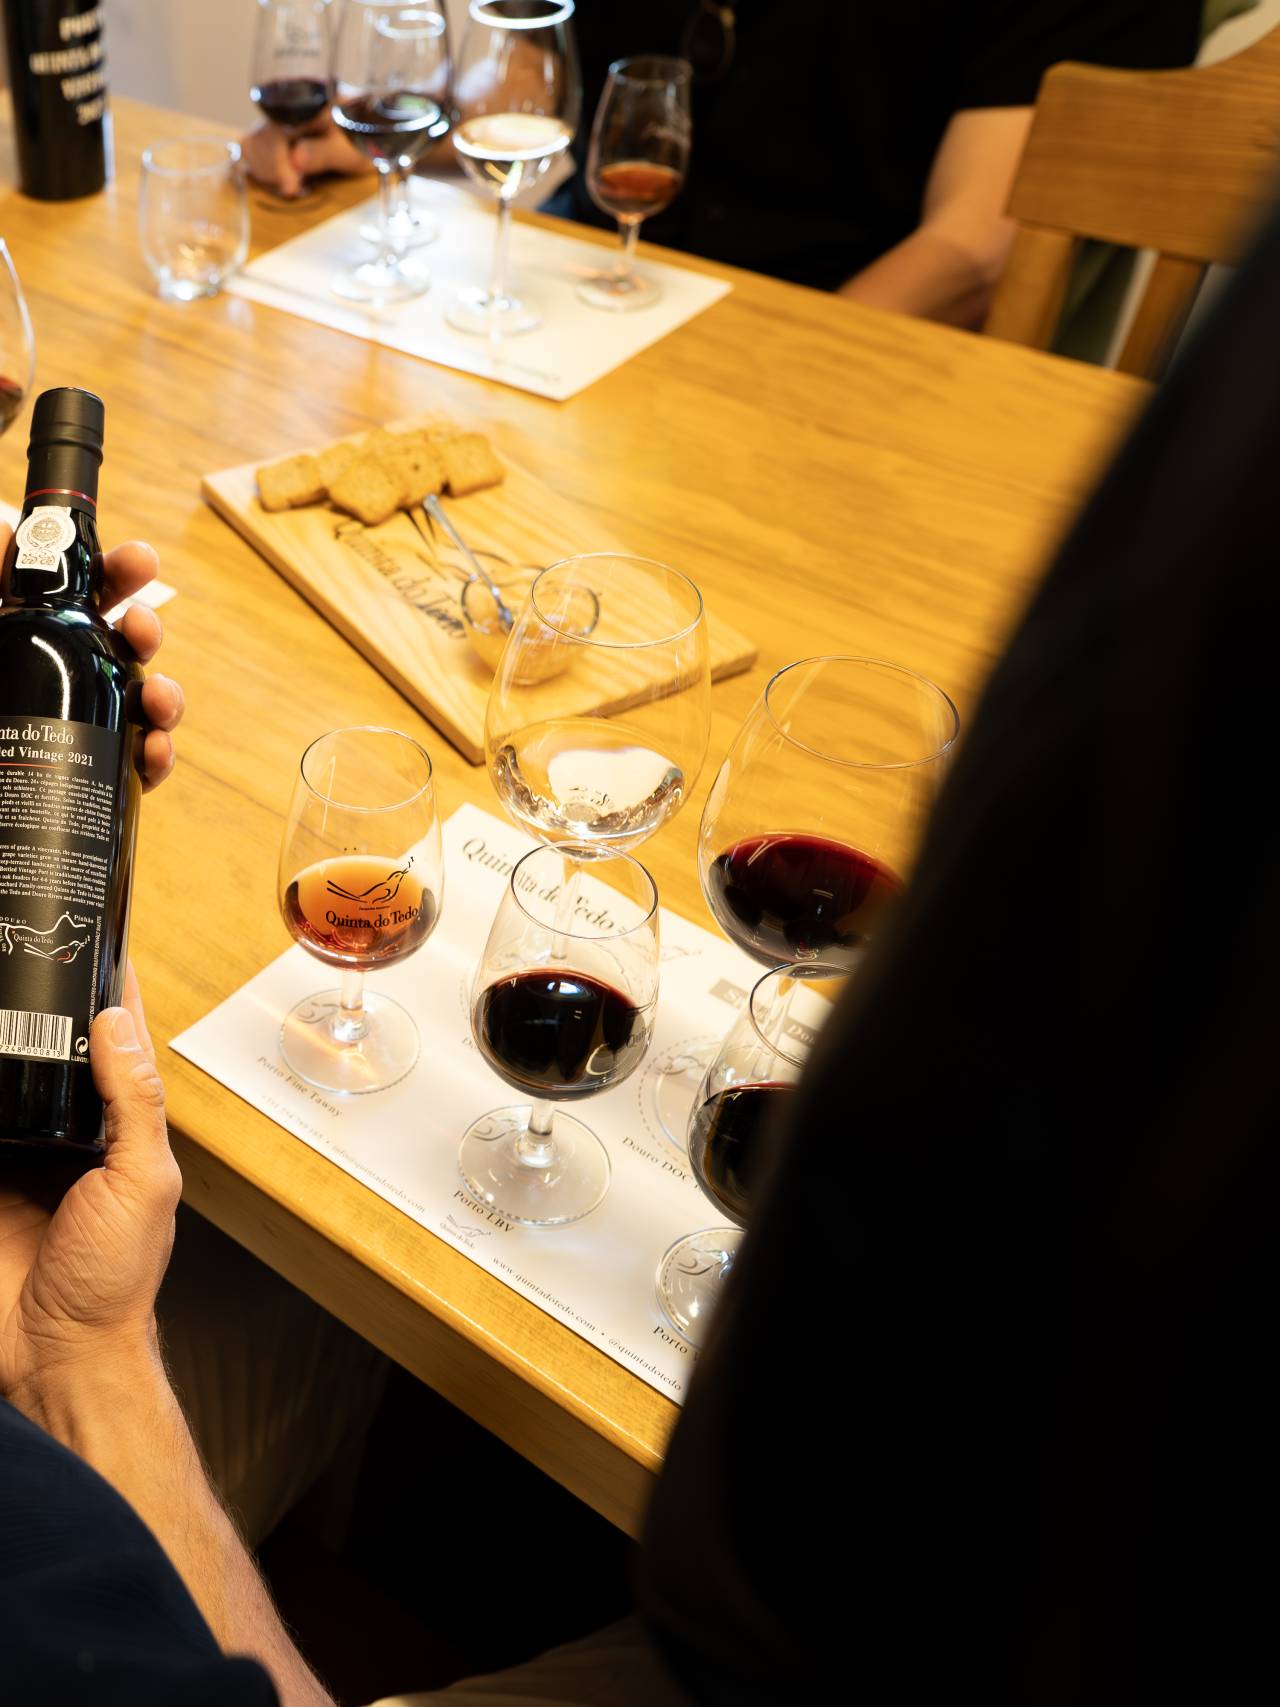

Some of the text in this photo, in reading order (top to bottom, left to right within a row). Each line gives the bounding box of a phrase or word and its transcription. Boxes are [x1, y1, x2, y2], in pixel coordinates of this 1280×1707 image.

[22, 723, 40, 742] do
[40, 724, 74, 745] Tedo
[18, 746, 64, 763] Vintage
[67, 751, 94, 767] 2021
[0, 916, 27, 924] DOURO
[325, 906, 419, 928] Quinta do Tedo
[13, 933, 33, 942] Quinta
[258, 1056, 284, 1078] Porto
[284, 1076, 308, 1094] Fine
[310, 1090, 344, 1118] Tawny
[622, 1136, 694, 1184] Douro DOC
[453, 1190, 516, 1234] Porto LBV
[493, 1257, 597, 1332] www.quintadotedo.com
[652, 1325, 688, 1354] Porto
